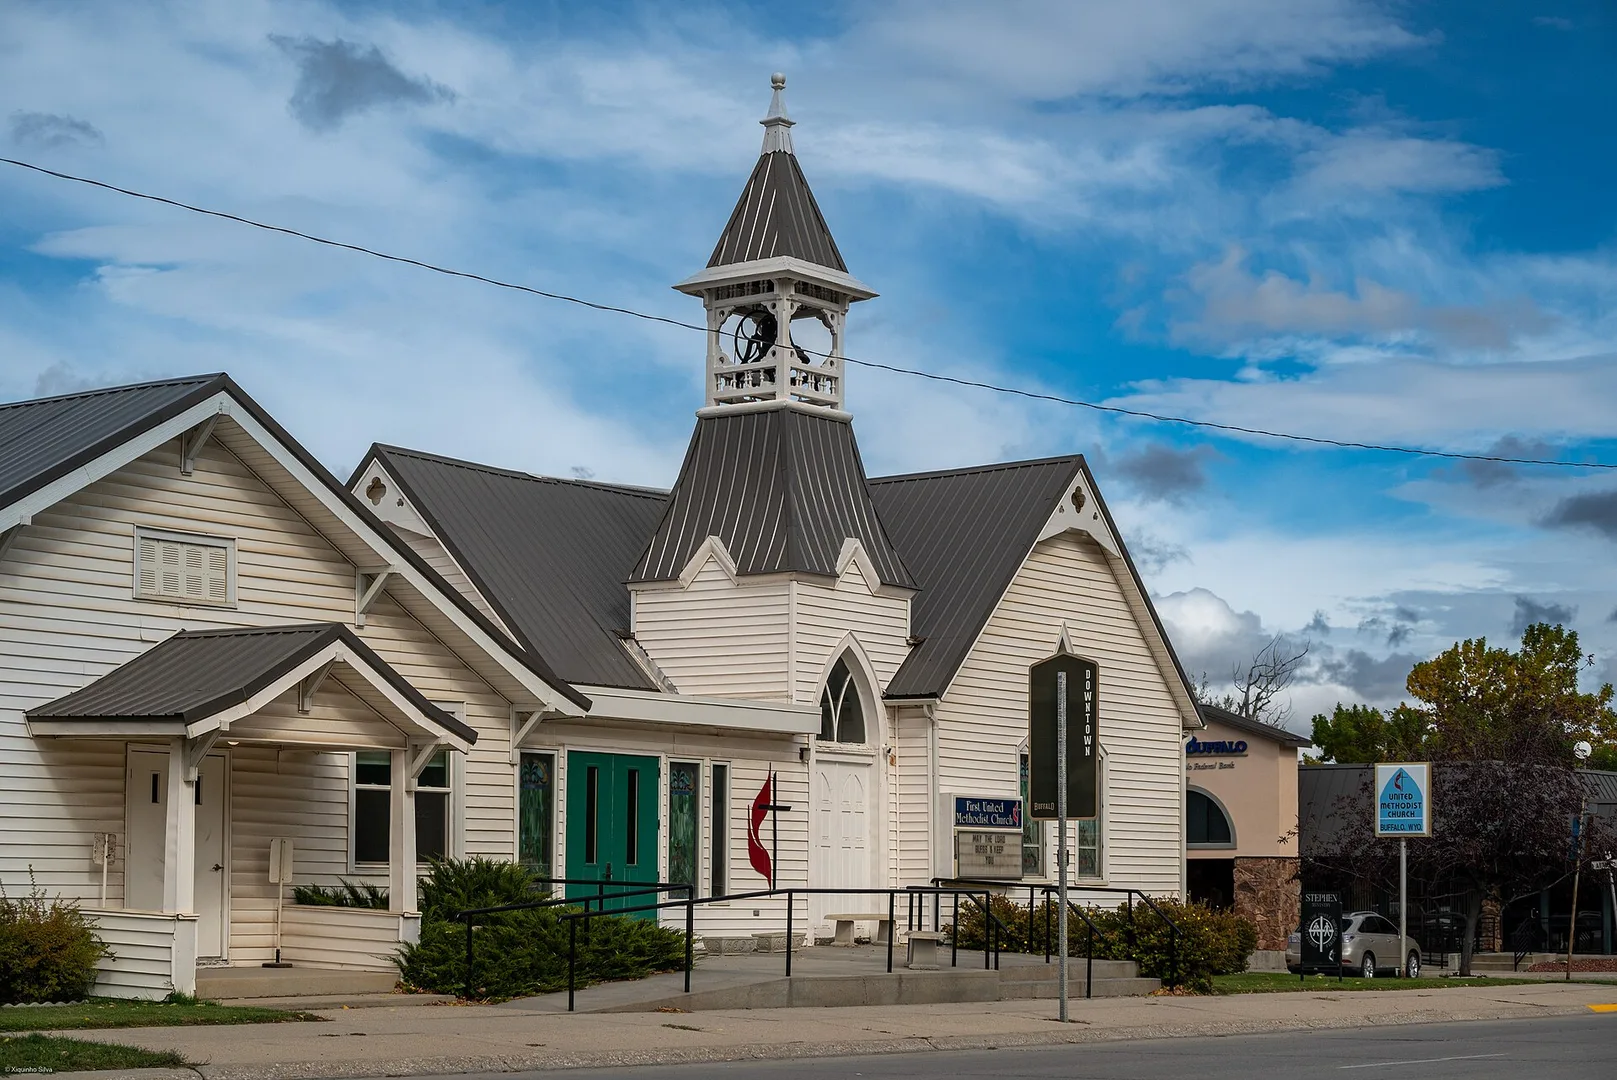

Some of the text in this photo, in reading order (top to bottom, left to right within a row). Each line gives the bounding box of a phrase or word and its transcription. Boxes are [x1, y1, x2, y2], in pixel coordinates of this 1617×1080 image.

[1084, 669, 1092, 756] DOWNTOWN
[966, 801, 1004, 813] First United
[957, 812, 1013, 826] Methodist Church
[972, 834, 1006, 844] MAY THE LORD
[975, 845, 988, 854] BLESS
[994, 846, 1004, 854] KEEP
[985, 856, 994, 865] YOU
[1305, 893, 1338, 902] STEPHEN
